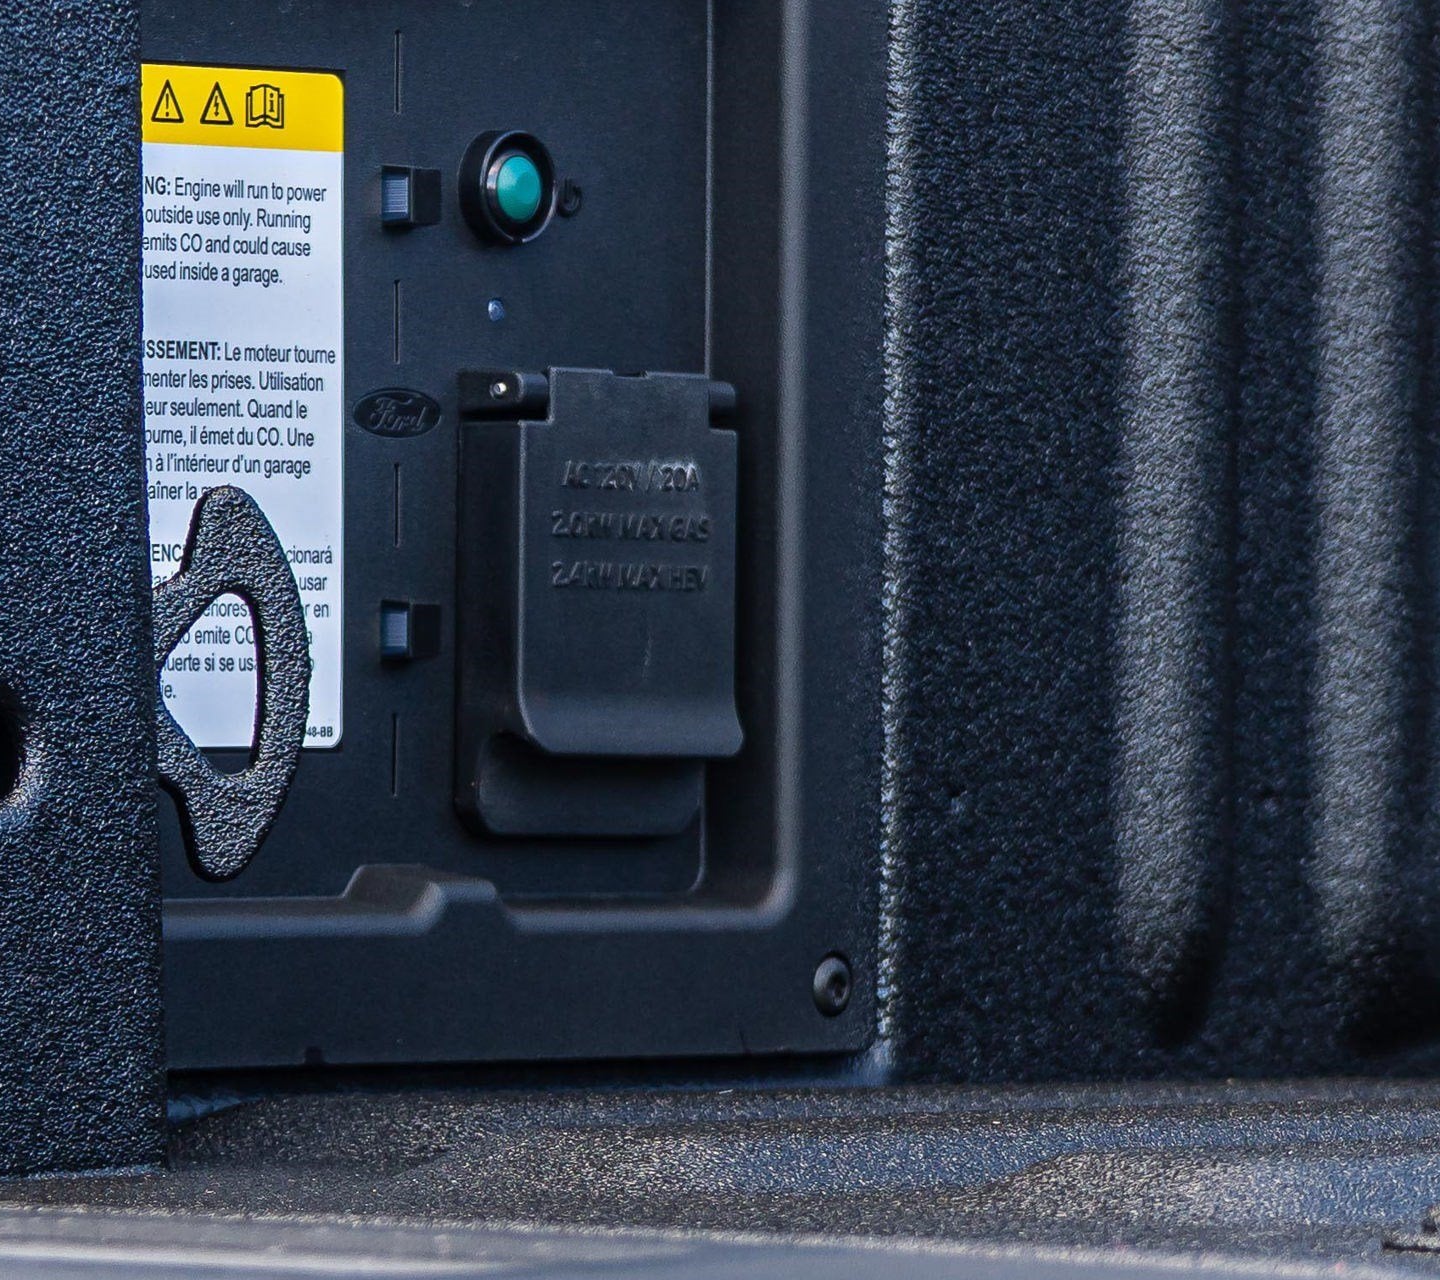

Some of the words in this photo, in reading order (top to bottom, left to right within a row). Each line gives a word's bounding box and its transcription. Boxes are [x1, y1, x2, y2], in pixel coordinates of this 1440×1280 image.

[175, 177, 220, 201] Engine
[224, 180, 243, 198] will
[248, 185, 268, 199] run
[272, 182, 283, 200] to
[287, 186, 326, 204] power
[146, 205, 192, 224] outside
[197, 212, 219, 225] use
[223, 208, 253, 231] only.
[257, 208, 310, 233] Running
[143, 233, 176, 251] emits
[180, 233, 202, 252] CO
[206, 236, 229, 254] and
[234, 237, 268, 255] could
[272, 243, 310, 256] cause
[145, 262, 176, 279] used
[180, 262, 217, 280] inside
[222, 269, 229, 281] a
[233, 268, 283, 288] garage.
[144, 340, 220, 360] SSEMENT:
[225, 342, 241, 361] Le
[245, 344, 292, 363] moteur
[294, 346, 335, 364] tourne
[143, 370, 186, 387] menter
[189, 369, 207, 388] les
[212, 371, 254, 393] prises.
[259, 371, 323, 391] Utilisation
[170, 398, 243, 417] seulement.
[248, 399, 292, 419] Quand
[296, 401, 307, 419] le
[369, 396, 426, 430] Ford
[145, 429, 186, 446] ourne,
[190, 426, 196, 444] il
[200, 426, 234, 445] émet
[237, 427, 253, 445] du
[257, 427, 283, 446] CO.
[288, 428, 314, 446] Une
[156, 454, 163, 471] à
[167, 454, 229, 472] l'intérieur
[233, 454, 260, 473] d'un
[264, 459, 310, 478] garage
[661, 458, 700, 492] 20A
[149, 481, 183, 499] aîner
[186, 482, 197, 500] la
[619, 512, 664, 541] MAX
[286, 546, 332, 564] cionará
[299, 578, 327, 590] usar
[619, 562, 665, 591] MAX
[314, 605, 329, 617] en
[195, 627, 230, 644] emite
[166, 654, 200, 671] uerte
[205, 654, 215, 671] si
[219, 659, 234, 671] se
[302, 726, 333, 737] 48-BB
